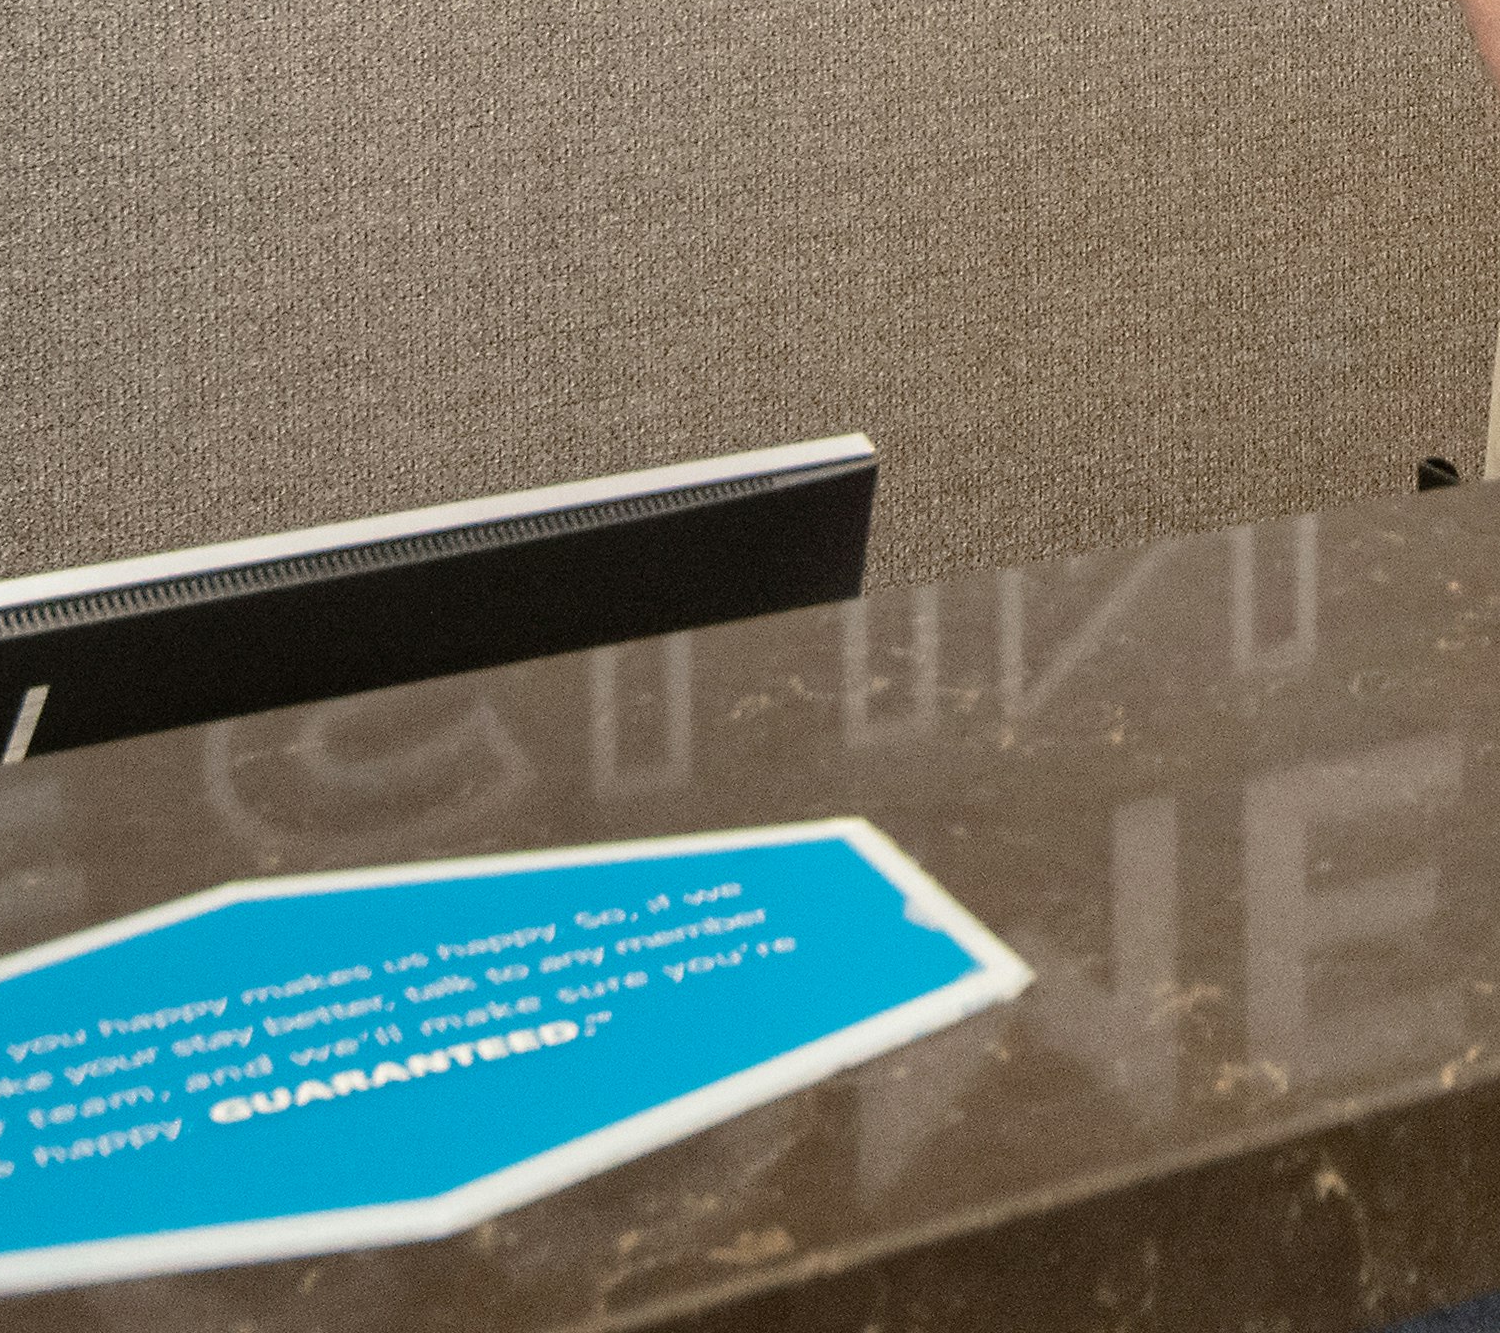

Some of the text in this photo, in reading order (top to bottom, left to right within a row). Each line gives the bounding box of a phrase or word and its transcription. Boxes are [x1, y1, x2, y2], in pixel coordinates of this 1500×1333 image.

[6, 1029, 87, 1063] you
[99, 997, 229, 1037] happy
[240, 964, 372, 1006] makes
[383, 952, 429, 974] us
[647, 893, 671, 915] if
[682, 881, 743, 906] we
[28, 1085, 171, 1129] team,
[185, 1052, 274, 1093] and
[290, 1023, 403, 1067] we'll
[420, 995, 542, 1038] make
[556, 970, 649, 1005] sure
[662, 935, 797, 984] you're
[64, 1046, 159, 1086] your
[171, 1025, 254, 1058] stay
[404, 974, 478, 1004] talk
[485, 963, 530, 985] to
[538, 945, 605, 974] any
[614, 907, 767, 956] member
[32, 1118, 182, 1168] happy
